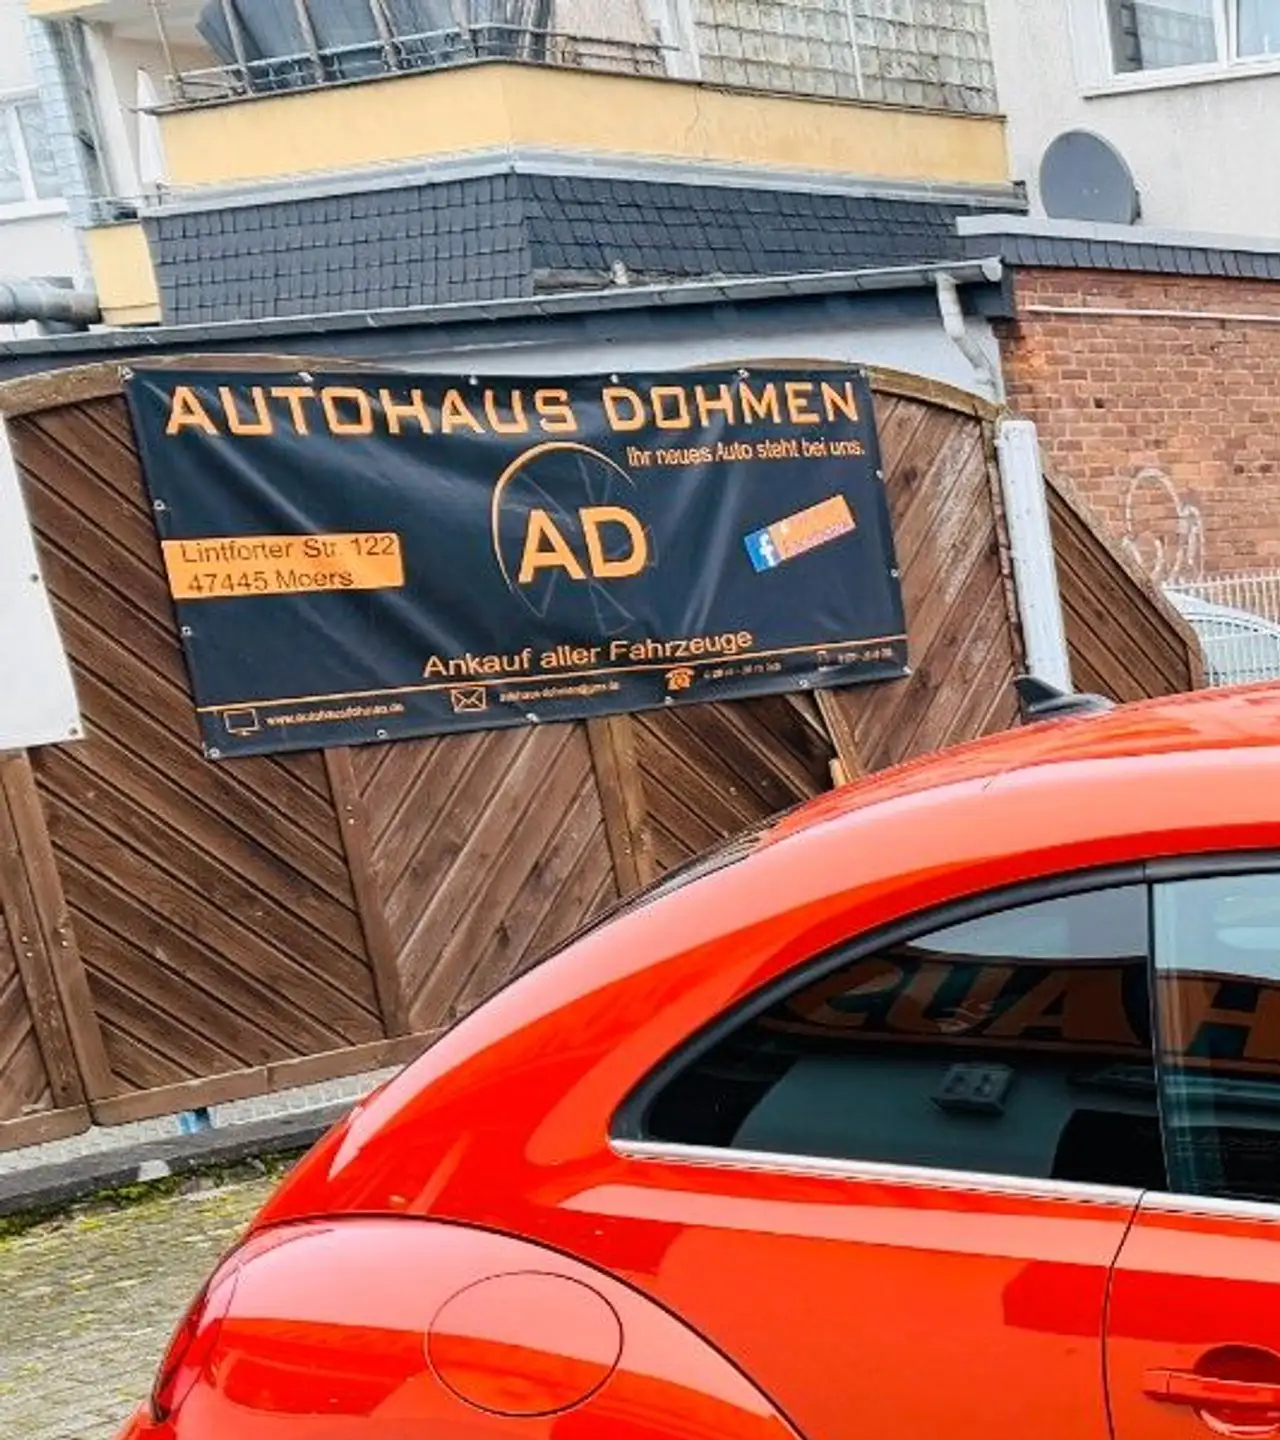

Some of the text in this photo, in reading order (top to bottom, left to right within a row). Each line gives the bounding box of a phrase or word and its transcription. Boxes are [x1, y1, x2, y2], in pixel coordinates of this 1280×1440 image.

[165, 381, 859, 436] AUTOHAUS DOHMEN
[626, 437, 865, 467] Ihr neues Auto steht bei uns.
[180, 537, 293, 565] Lintforter
[350, 535, 394, 556] 122
[518, 506, 648, 584] AD
[187, 567, 354, 594] 47445 Moers
[422, 630, 753, 679] Ankauf aller Fahrzeuge
